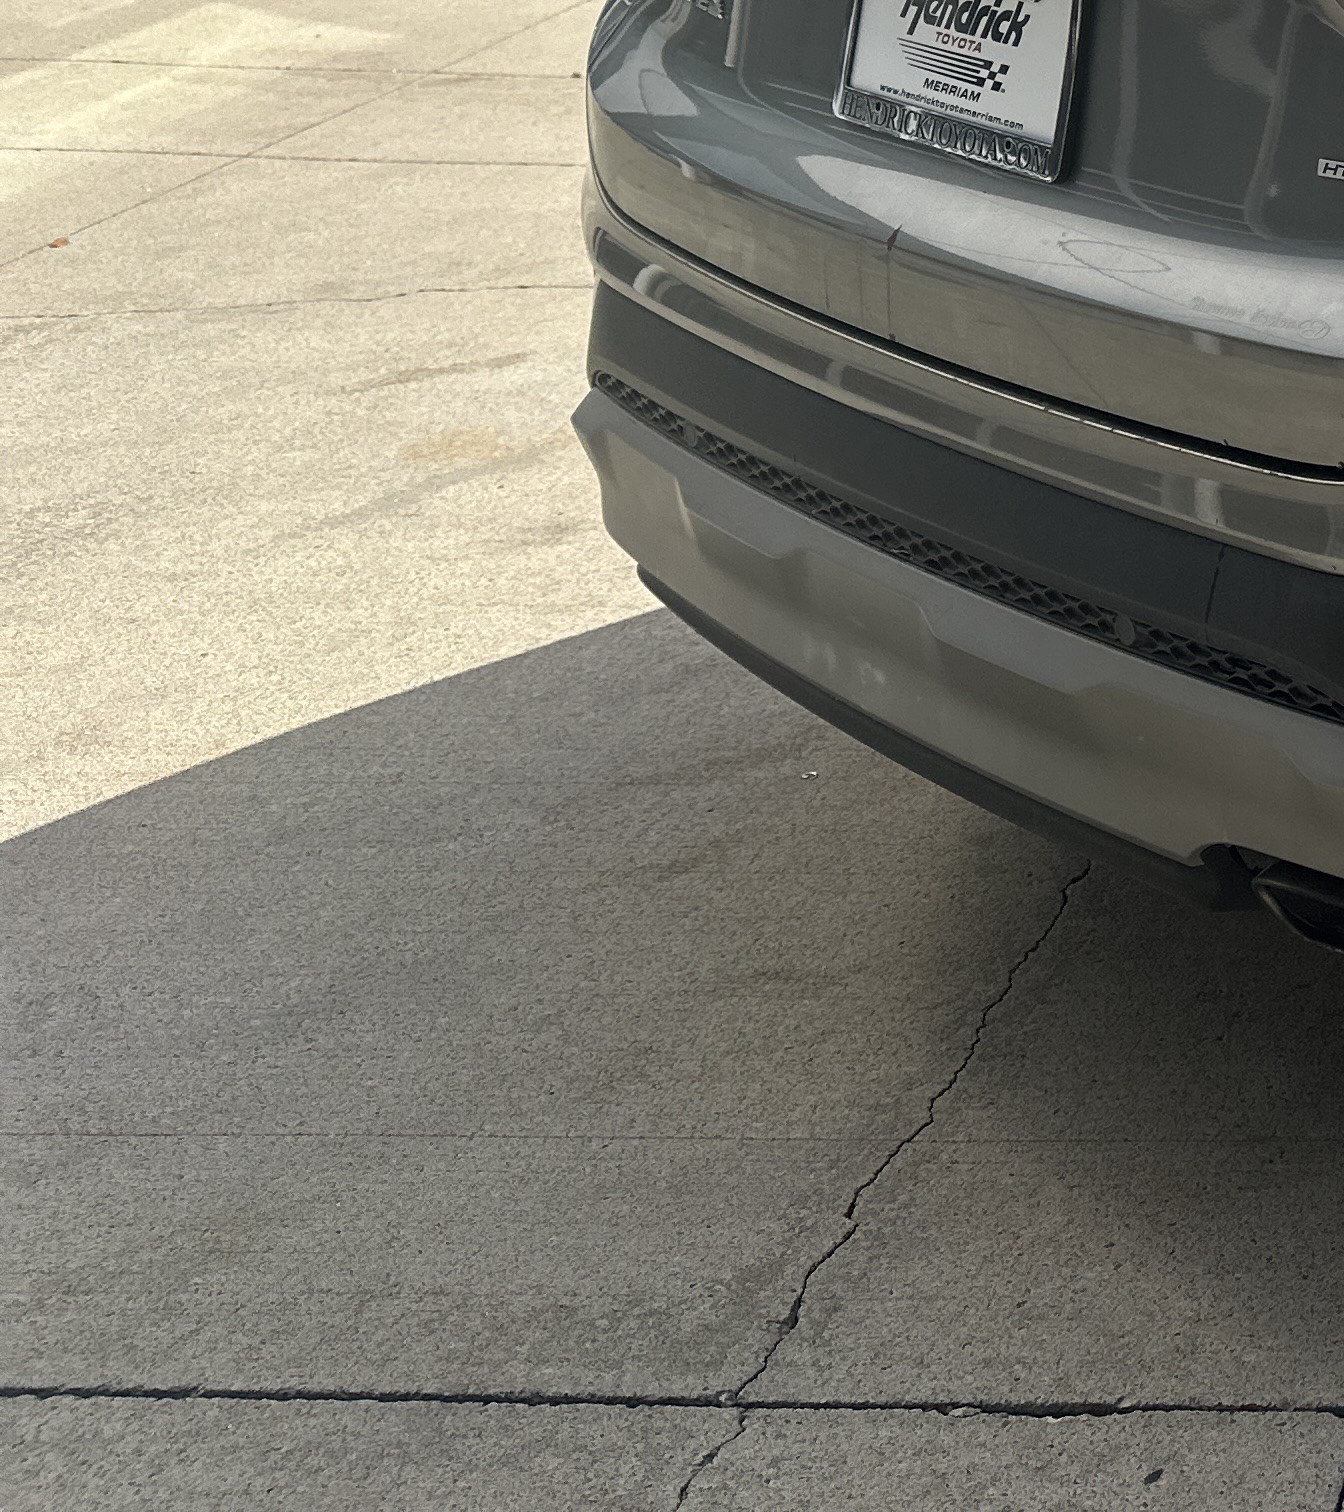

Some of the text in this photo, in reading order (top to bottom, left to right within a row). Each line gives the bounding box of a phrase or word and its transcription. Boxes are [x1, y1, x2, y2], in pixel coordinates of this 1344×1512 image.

[936, 31, 983, 54] TOYOTA
[923, 78, 982, 103] MERRIAM
[880, 84, 1024, 131] www.hendricktoyotamerriam.com
